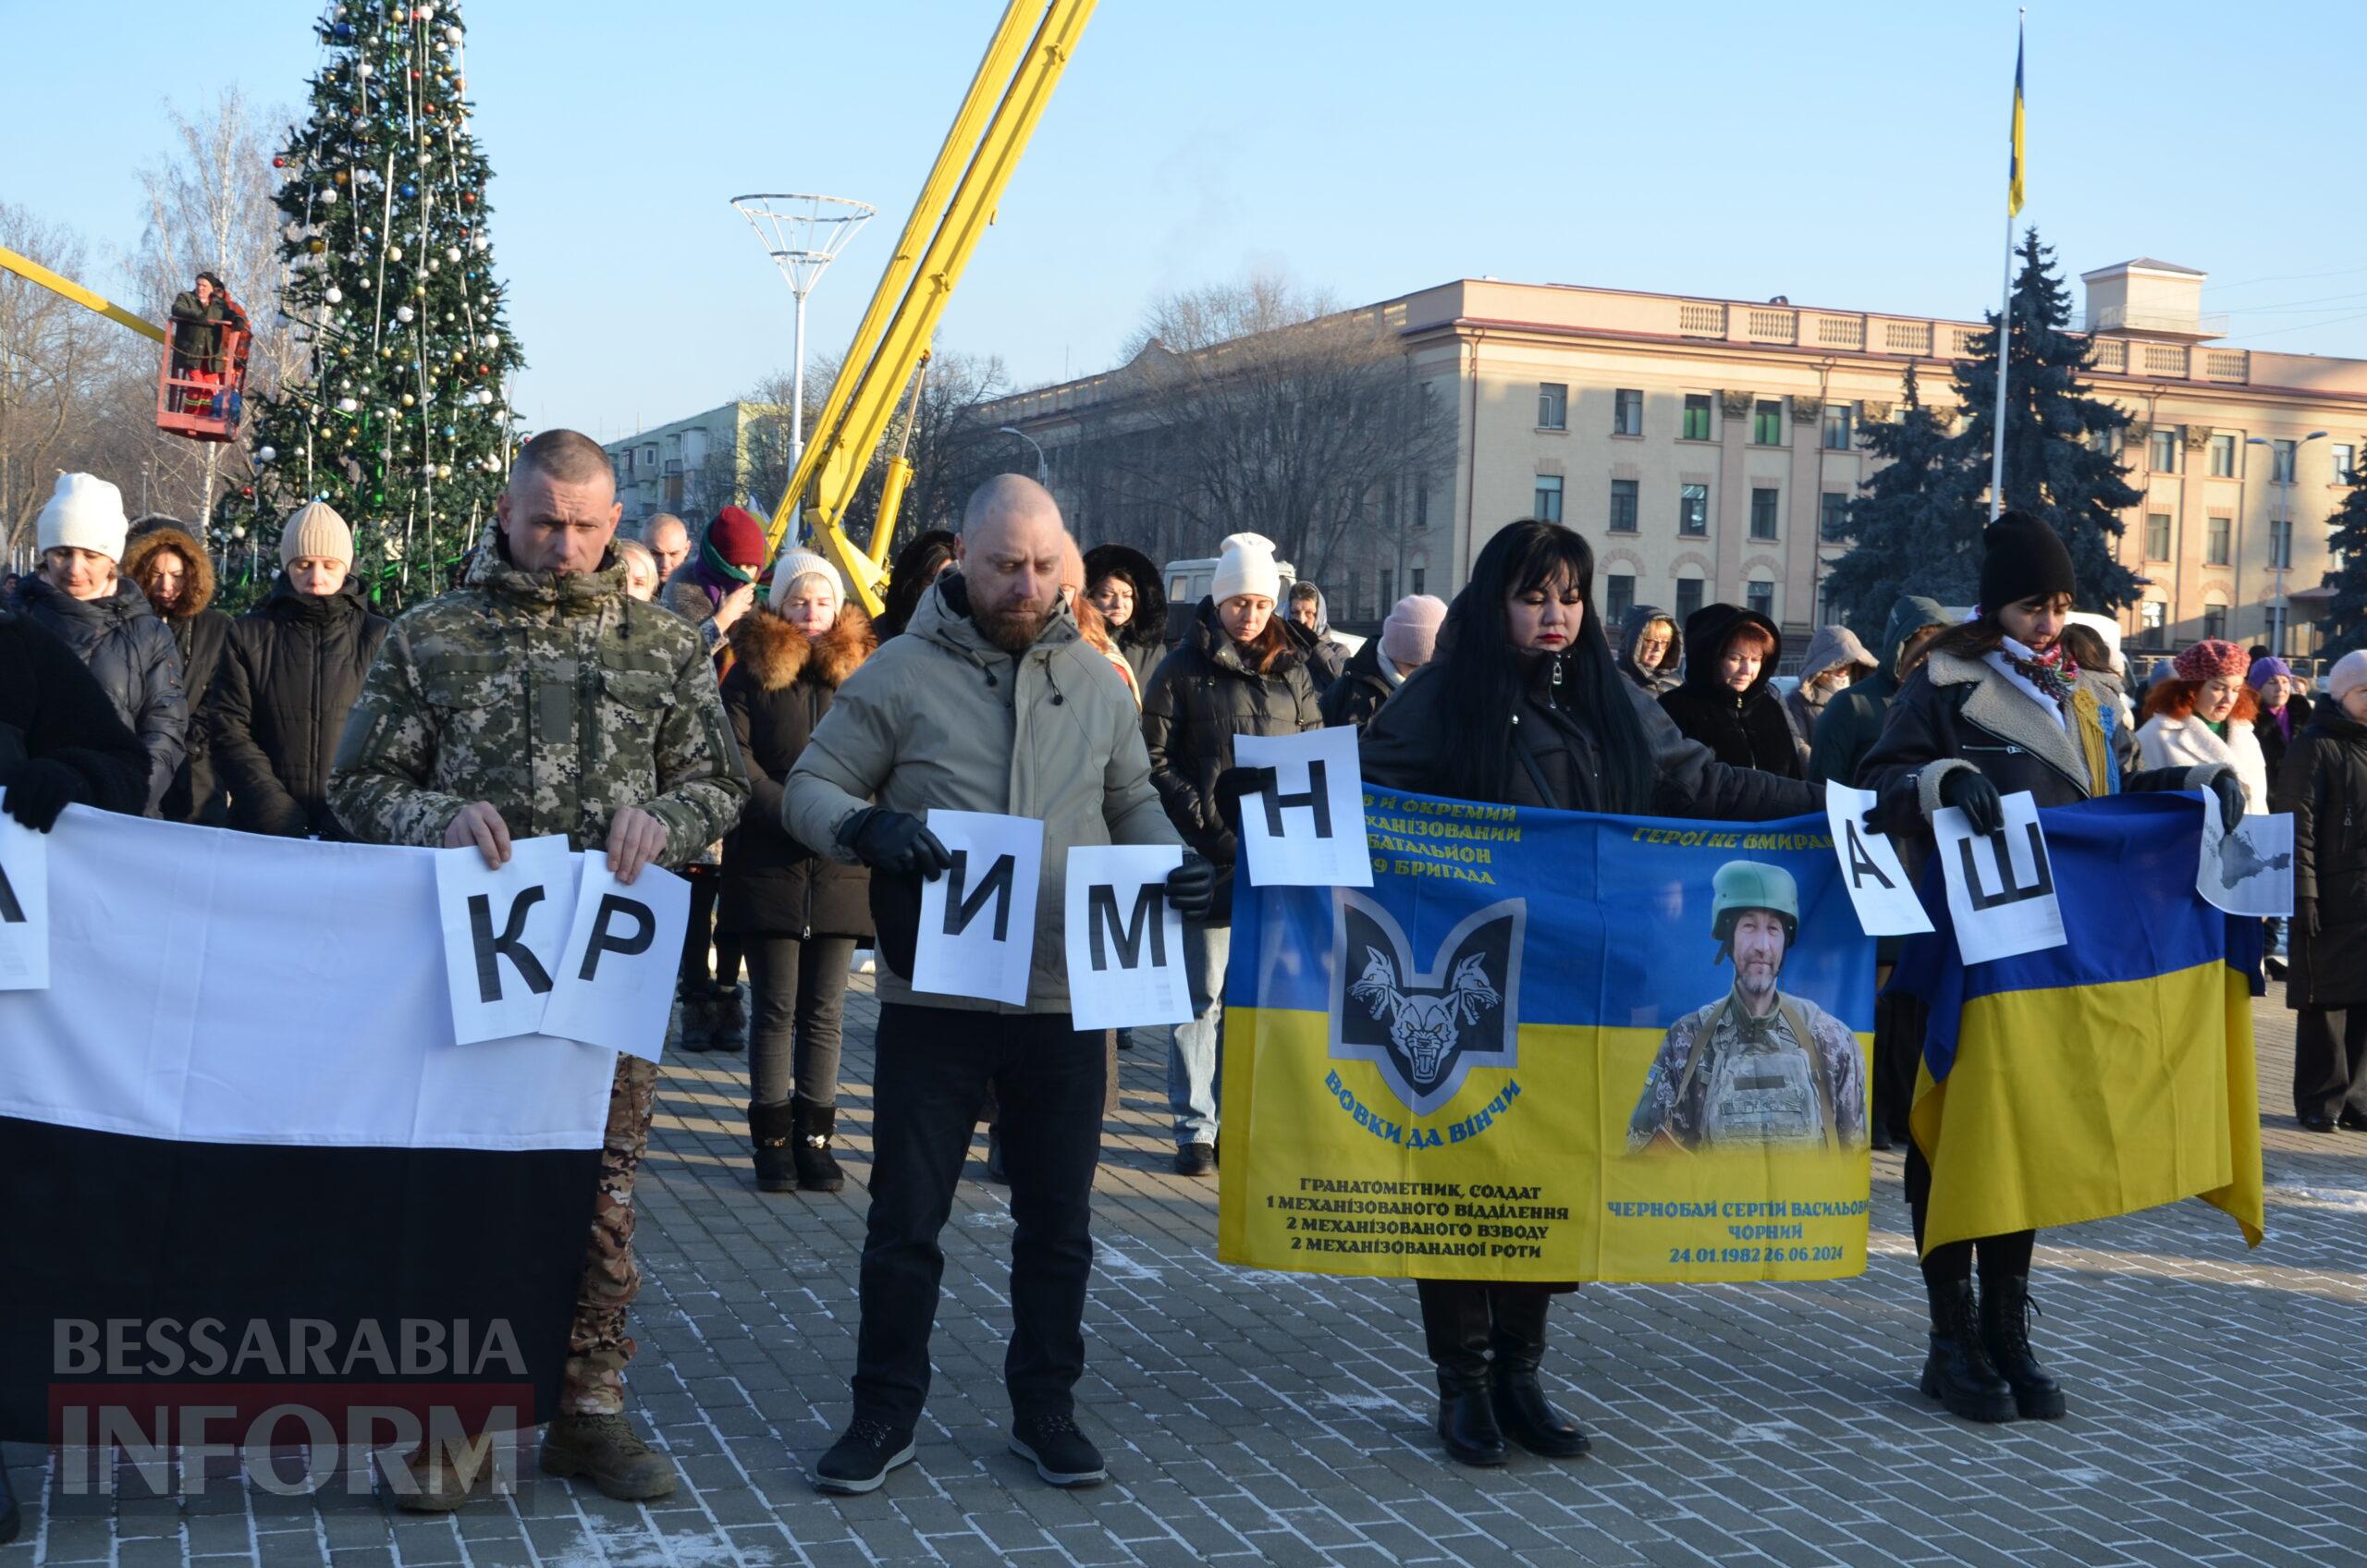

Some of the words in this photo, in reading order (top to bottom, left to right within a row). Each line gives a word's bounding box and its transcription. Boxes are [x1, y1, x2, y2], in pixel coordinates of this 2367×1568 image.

[1258, 759, 1333, 839] Н
[1402, 799, 1517, 822] ОКРЕМИЙ
[1364, 815, 1523, 842] ХАНІЗОВАНИЙ
[1632, 827, 1709, 847] ГЕРОЇ
[1707, 833, 1741, 848] НЕ
[1742, 833, 1834, 851] ВМИРА
[1367, 833, 1491, 864] БАТАЛЬЙОН
[1846, 818, 1896, 889] А
[1370, 857, 1388, 873] 9
[1394, 859, 1496, 885] БРИГАДА
[1957, 821, 2054, 912] Ш
[943, 849, 1016, 942] И
[578, 893, 656, 982] Р
[1088, 883, 1168, 972] М
[467, 885, 554, 1004] К
[1325, 1068, 1403, 1144] ВОВКИ
[1404, 1128, 1444, 1150] ДА
[1447, 1077, 1521, 1144] ВІНЧИ
[1300, 1177, 1465, 1199] ГРАНАТОМЕТНИК,
[1469, 1183, 1542, 1200] СОЛДАТ
[1267, 1195, 1275, 1208] 1
[1279, 1195, 1450, 1218] МЕХАНІЗОВАНОГО
[1454, 1203, 1569, 1220] ВІДДІЛЕННЯ
[1608, 1200, 1718, 1219] ЧЕРНОБАЙ
[1722, 1200, 1787, 1219] СЕРГІЙ
[1791, 1199, 1870, 1218] ВАСИЛЬОВ
[1286, 1217, 1297, 1230] 2
[1301, 1218, 1473, 1238] МЕХАНІЗОВАНОГО
[1478, 1224, 1550, 1241] ВЗВОДУ
[1728, 1223, 1803, 1241] ЧОРНИЙ
[1291, 1237, 1302, 1250] 2
[1490, 1243, 1542, 1258] РОТИ
[1669, 1248, 1760, 1264] 24.01.1982
[1764, 1246, 1844, 1264] 26.06.2024
